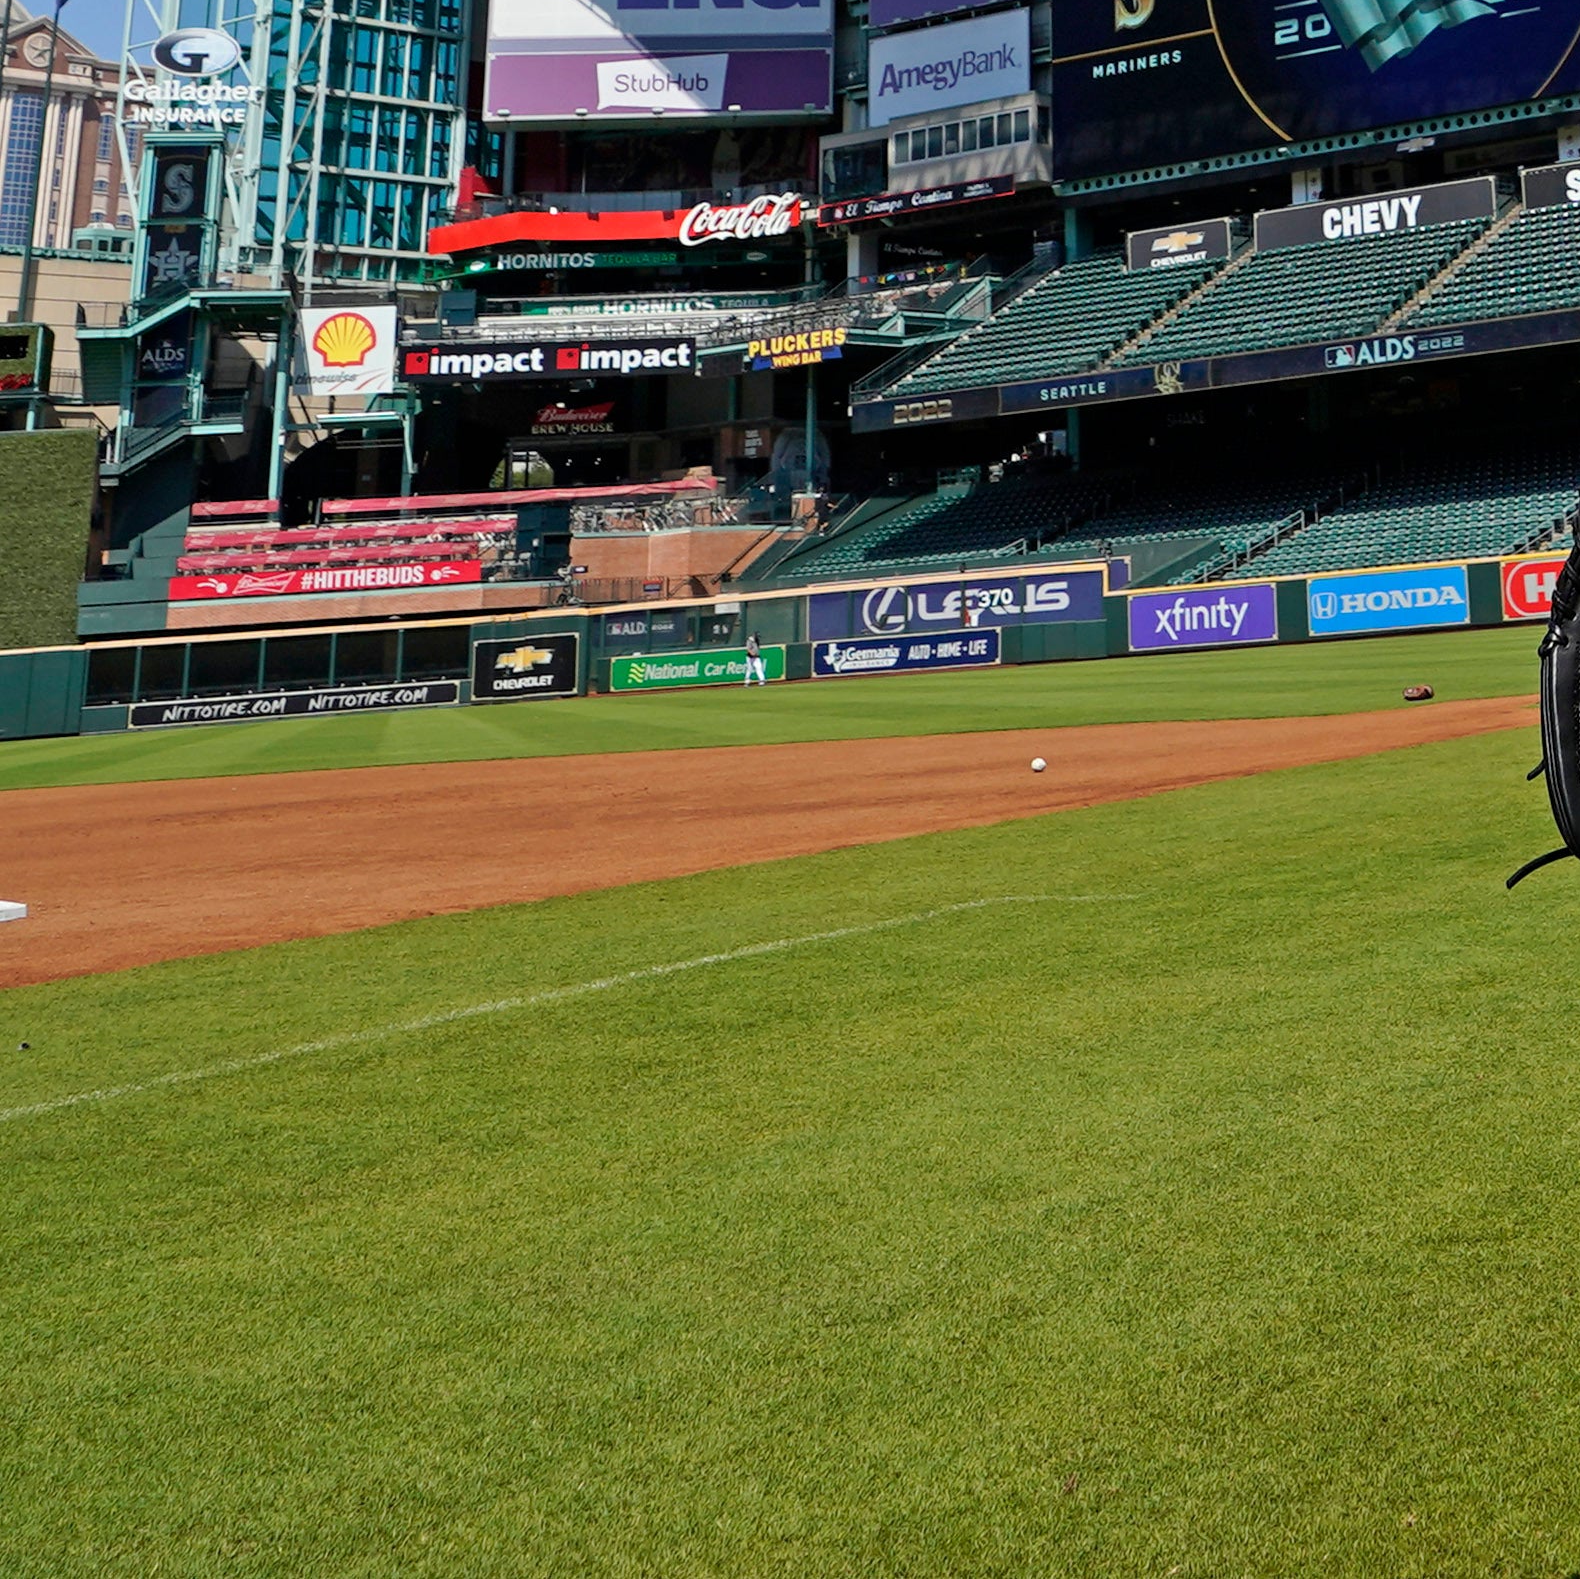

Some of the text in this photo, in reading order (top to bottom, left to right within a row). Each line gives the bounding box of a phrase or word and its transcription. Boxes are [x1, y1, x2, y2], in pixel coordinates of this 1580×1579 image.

[878, 43, 1016, 97] AmegyBank
[1091, 49, 1183, 79] MARINERS
[123, 78, 262, 105] Gallagher
[614, 72, 709, 93] StubHub
[132, 107, 246, 124] INSURANCE
[845, 203, 858, 218] El
[911, 190, 954, 207] Cantina
[1322, 195, 1423, 240] CHEVY
[498, 252, 678, 271] HORNITOS TEQUILA BAR
[1150, 250, 1209, 269] CHEVROLET
[603, 297, 716, 316] HORNITOS
[720, 297, 769, 309] TEQUILA
[748, 327, 847, 358] PLUCKERS
[1354, 334, 1465, 366] ALDS 2022
[141, 348, 186, 363] ALDS
[429, 342, 692, 379] impact impact
[772, 350, 823, 369] WING BAR
[1039, 381, 1107, 403] SEATTLE
[892, 399, 954, 425] 2022
[531, 422, 615, 435] BREW HOUSE
[300, 566, 424, 590] #HITTHEBUDS
[977, 587, 1014, 610] 370
[1339, 585, 1466, 622] HONDA
[1154, 593, 1250, 641] xfinity
[846, 639, 988, 661] Germania AUTO HOME LIFE
[644, 660, 699, 681] National
[704, 662, 726, 677] Car
[492, 674, 555, 691] CHEVROLET
[162, 687, 429, 723] NITTOTIRE.COM NITTOTIRE.COM
